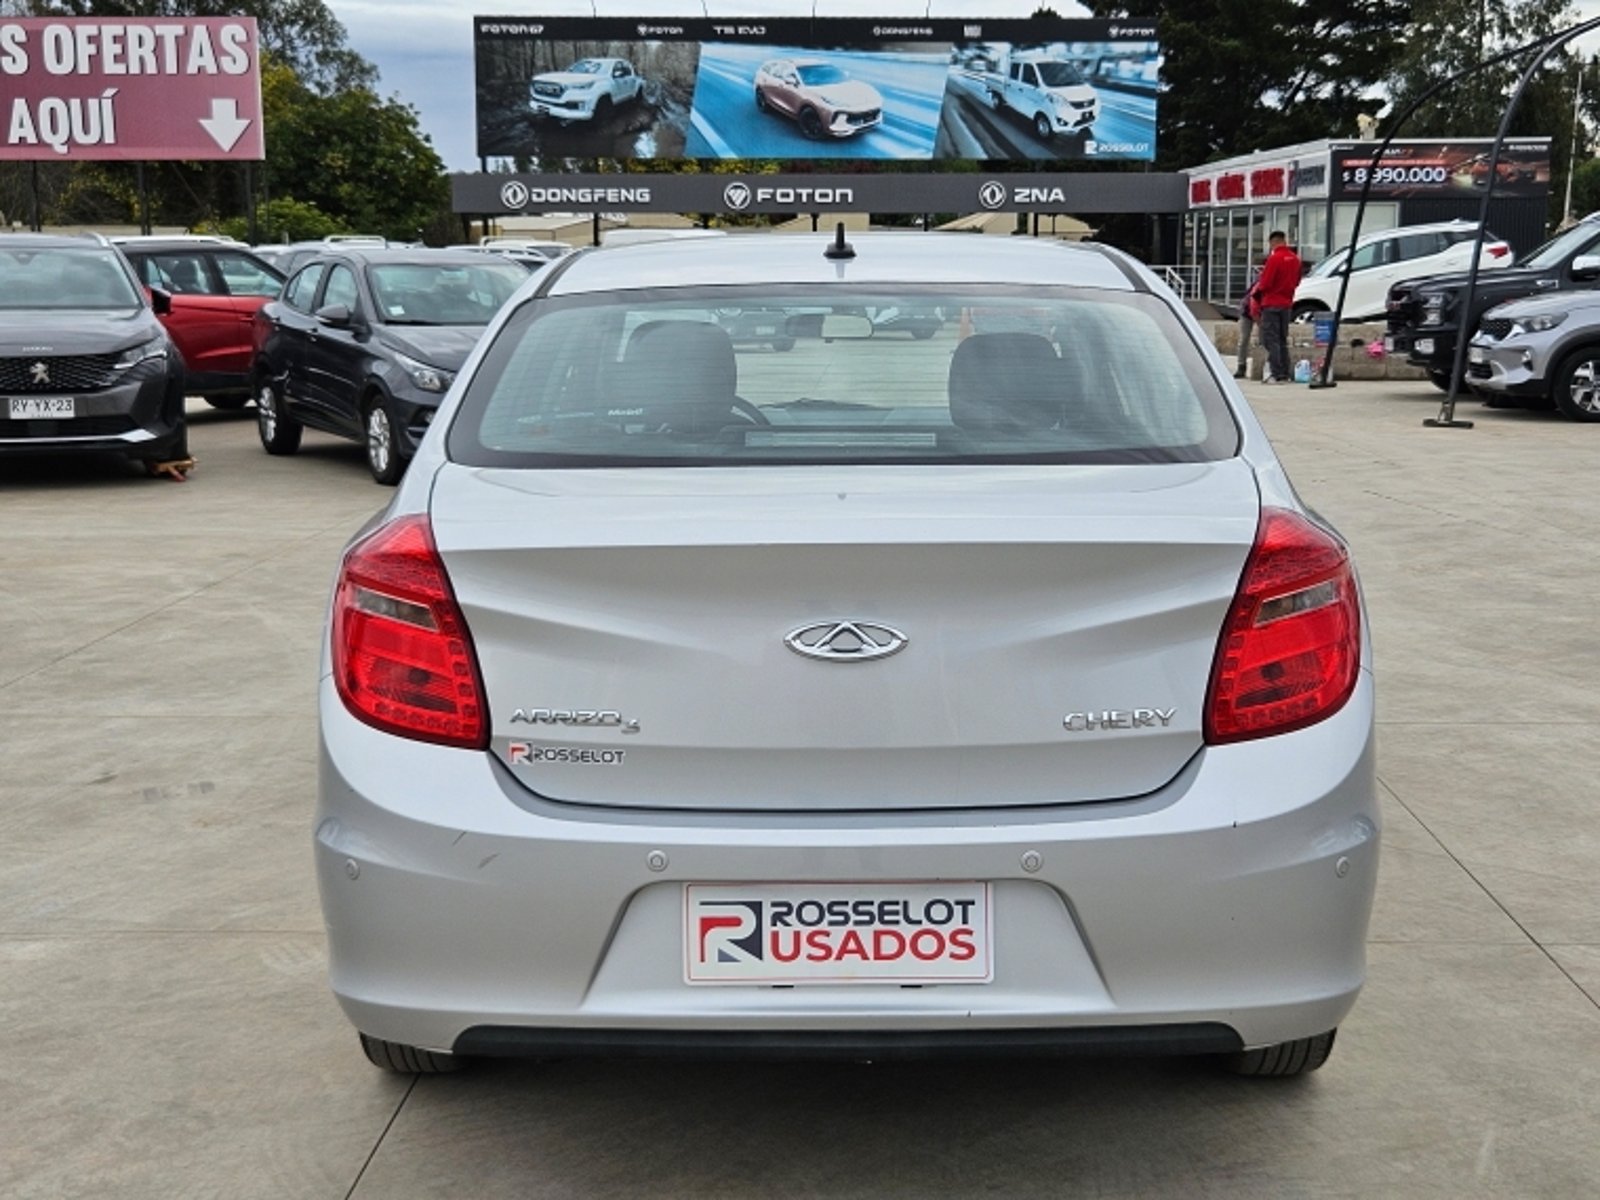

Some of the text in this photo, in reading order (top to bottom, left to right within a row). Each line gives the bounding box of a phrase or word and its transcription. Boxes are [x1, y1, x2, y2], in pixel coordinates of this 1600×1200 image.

[648, 26, 684, 35] FOTON
[1119, 26, 1156, 36] FOTON
[0, 24, 250, 76] S OFERTAS
[8, 88, 120, 154] AQUÍ
[1099, 142, 1149, 153] ROSSELOT
[531, 188, 651, 203] DONGFENG
[756, 188, 853, 203] FOTON
[1013, 187, 1066, 204] ZNA
[510, 707, 622, 727] ARRIZO
[1063, 707, 1177, 732] CHERY
[534, 747, 625, 764] ROSSELOT
[769, 898, 977, 928] ROSSELOT
[769, 927, 977, 963] USADOS
